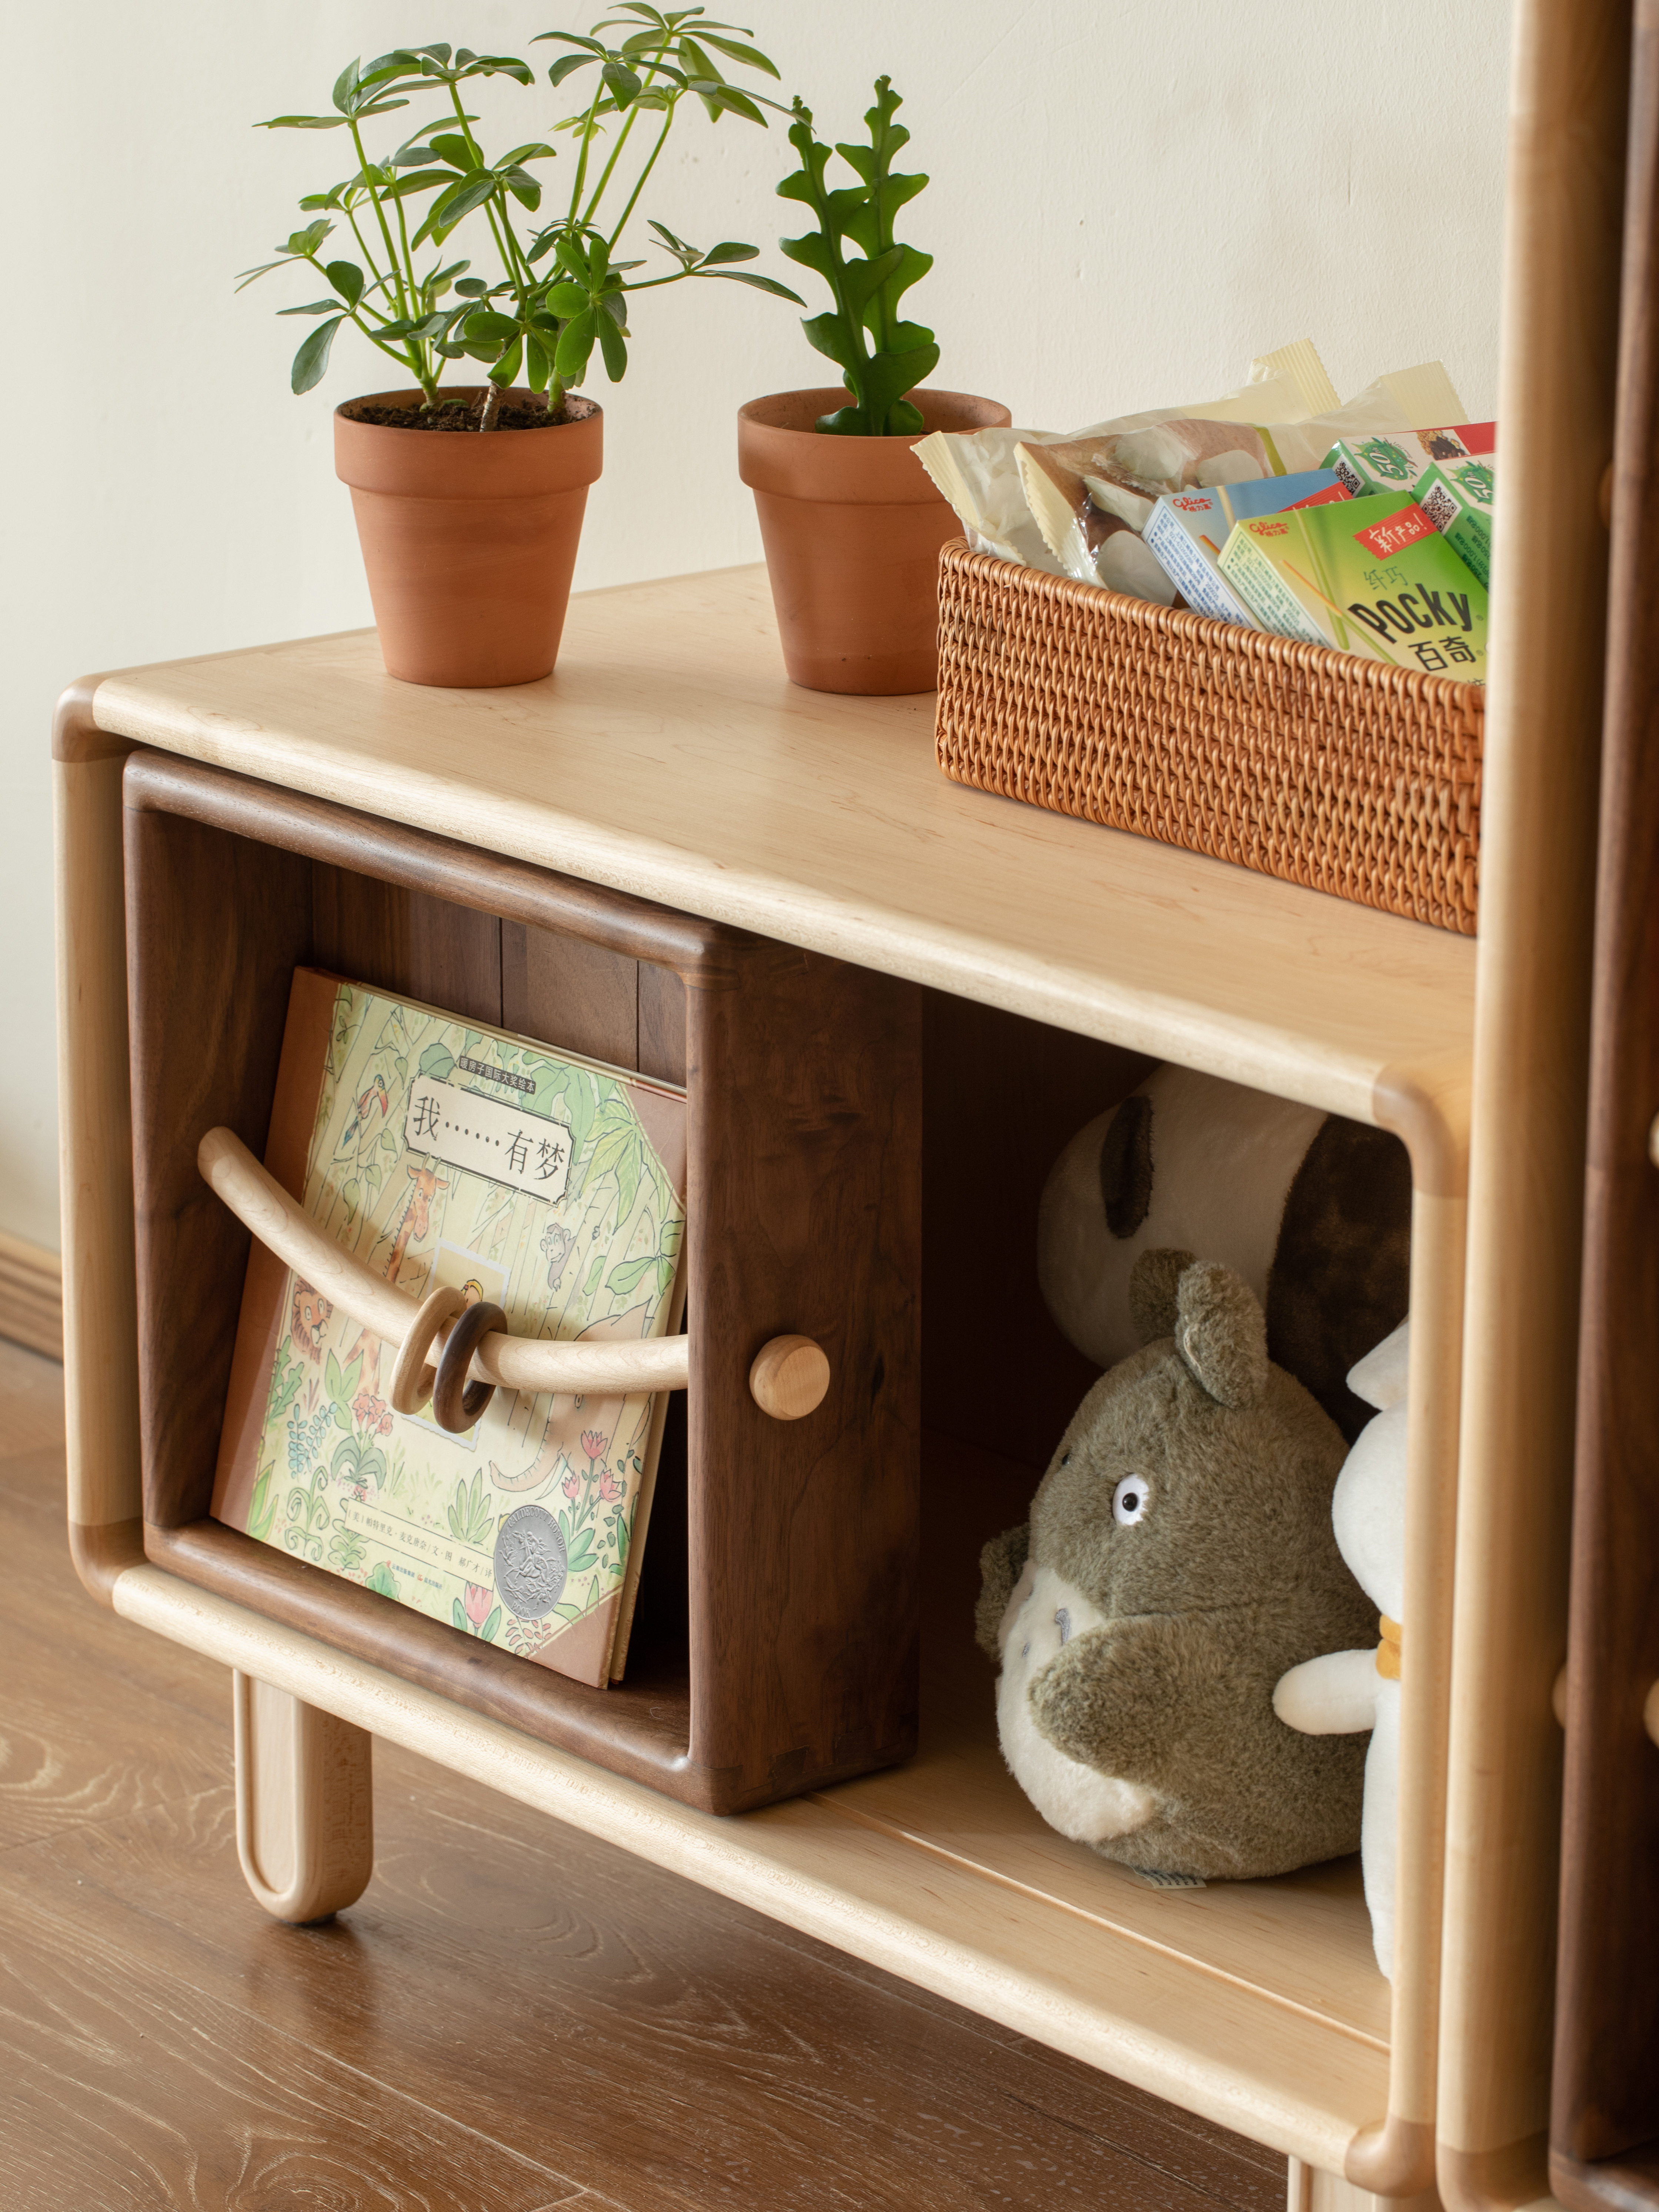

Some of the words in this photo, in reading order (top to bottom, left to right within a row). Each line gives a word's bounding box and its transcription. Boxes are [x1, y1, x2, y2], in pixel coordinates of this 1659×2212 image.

[1173, 497, 1212, 511] Glico
[1249, 522, 1288, 535] Glico
[1363, 566, 1408, 590] 纤巧
[1408, 636, 1476, 671] 百奇
[460, 1057, 535, 1092] 暖房子国际大奖绘本
[548, 1519, 565, 1553] HONOR
[511, 1601, 531, 1618] BOOK
